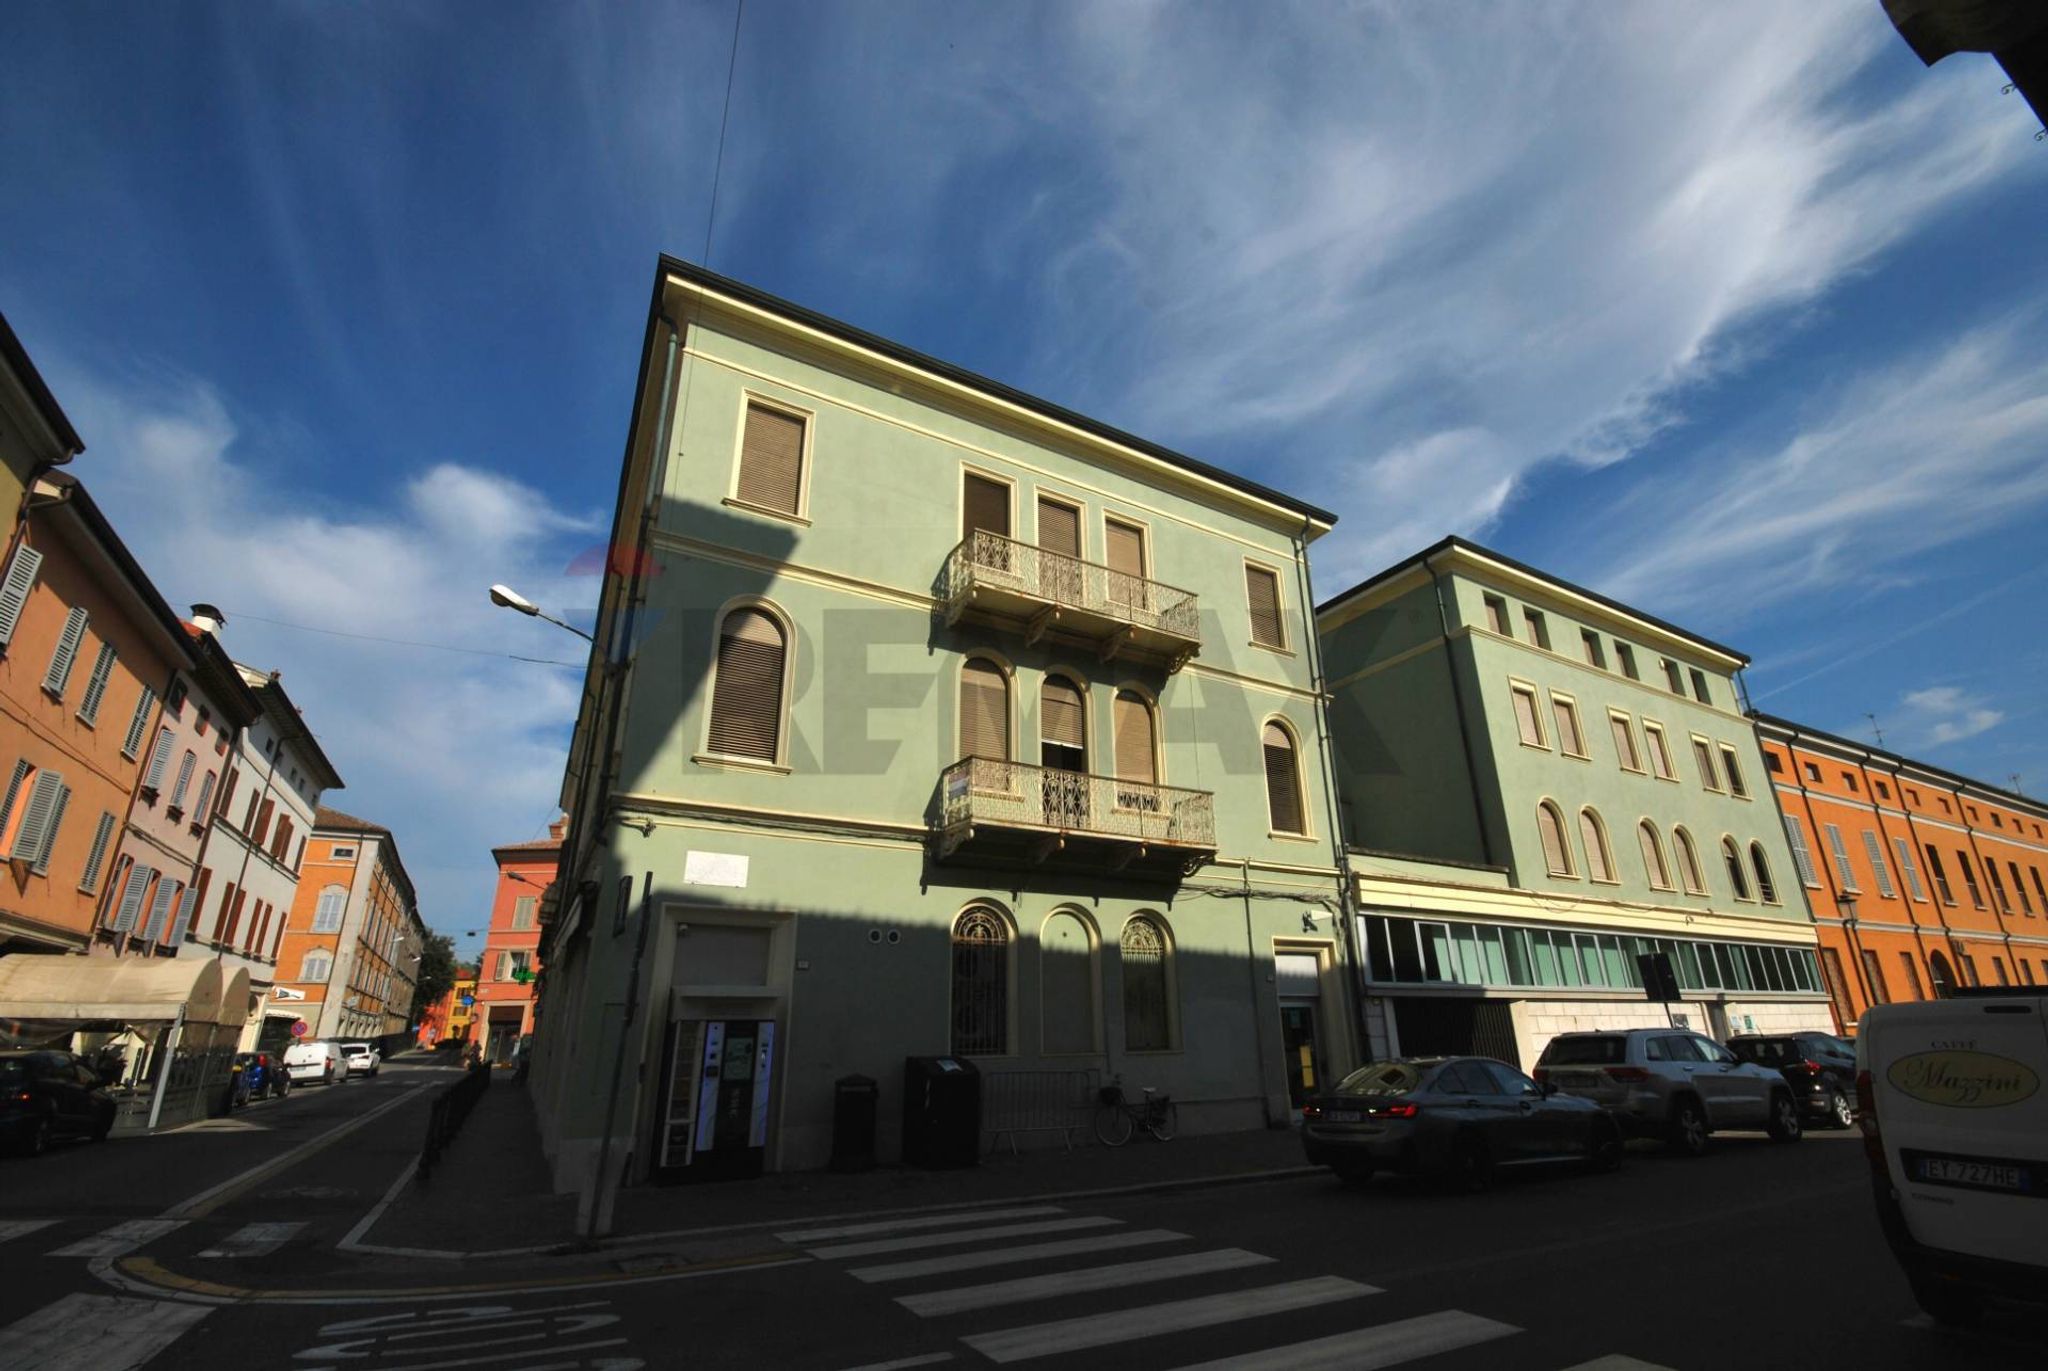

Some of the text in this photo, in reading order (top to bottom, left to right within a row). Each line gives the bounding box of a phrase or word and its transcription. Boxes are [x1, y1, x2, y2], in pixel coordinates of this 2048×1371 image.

[1904, 1059, 2021, 1102] Mazzini
[1929, 1160, 2018, 1186] EY 727HE
